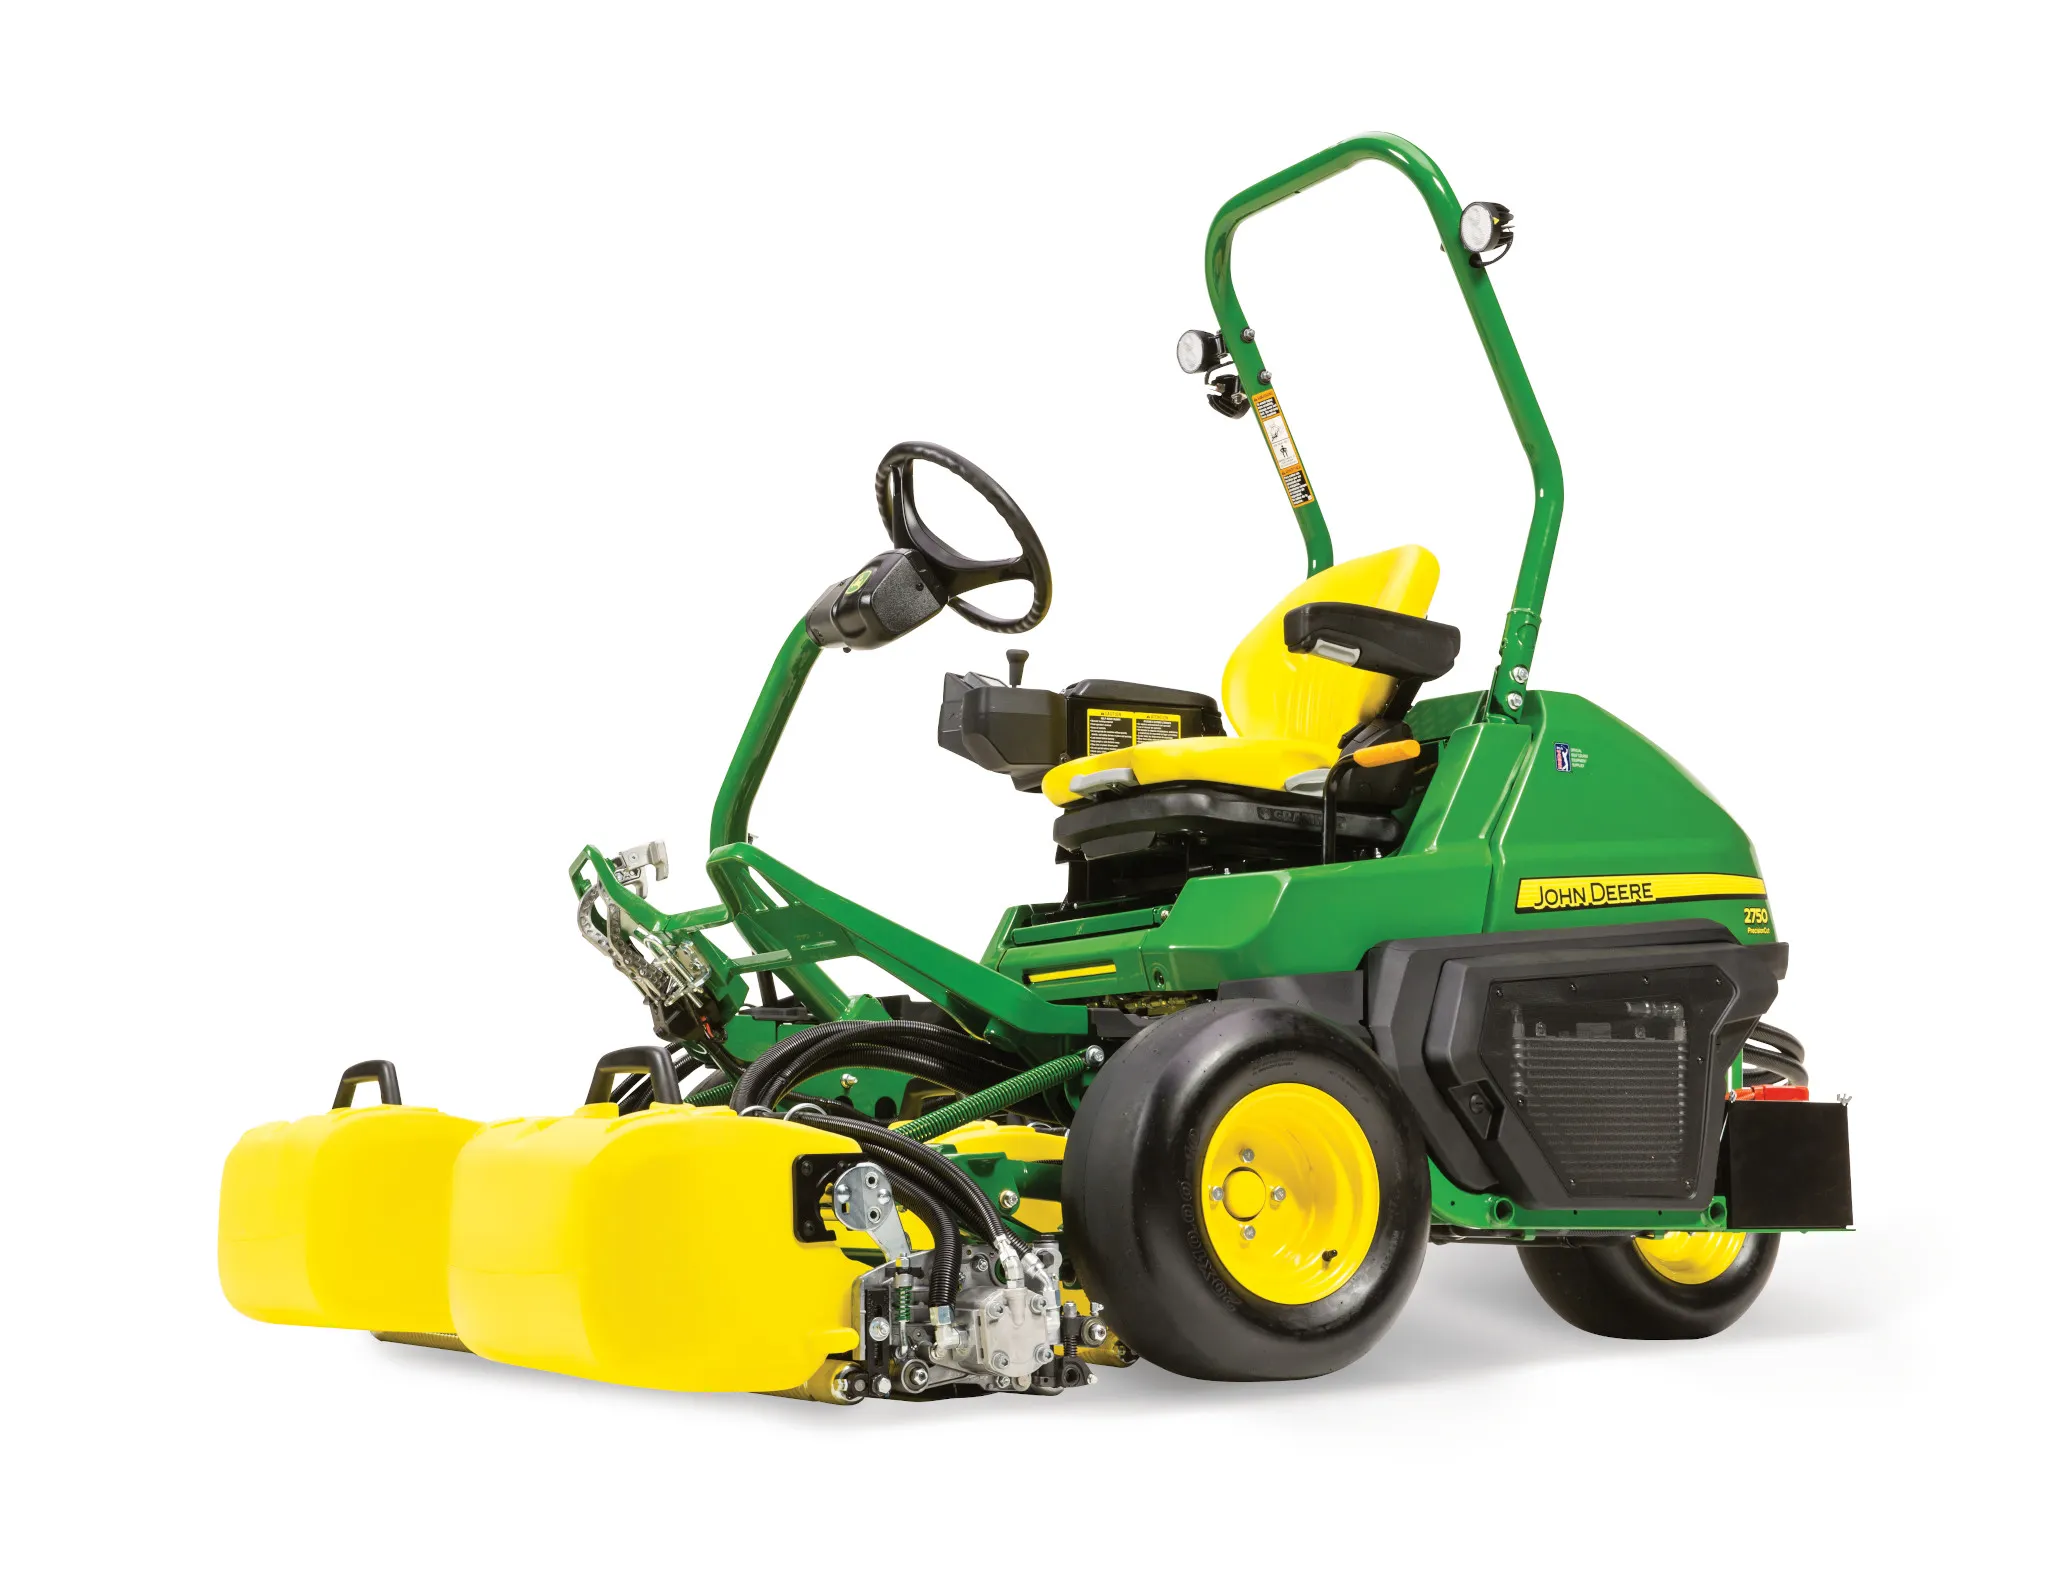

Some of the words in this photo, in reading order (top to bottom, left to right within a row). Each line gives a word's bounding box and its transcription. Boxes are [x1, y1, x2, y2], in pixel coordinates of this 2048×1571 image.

[1534, 886, 1586, 906] JOHN
[1590, 882, 1654, 902] DEERE
[1743, 907, 1768, 924] 2750
